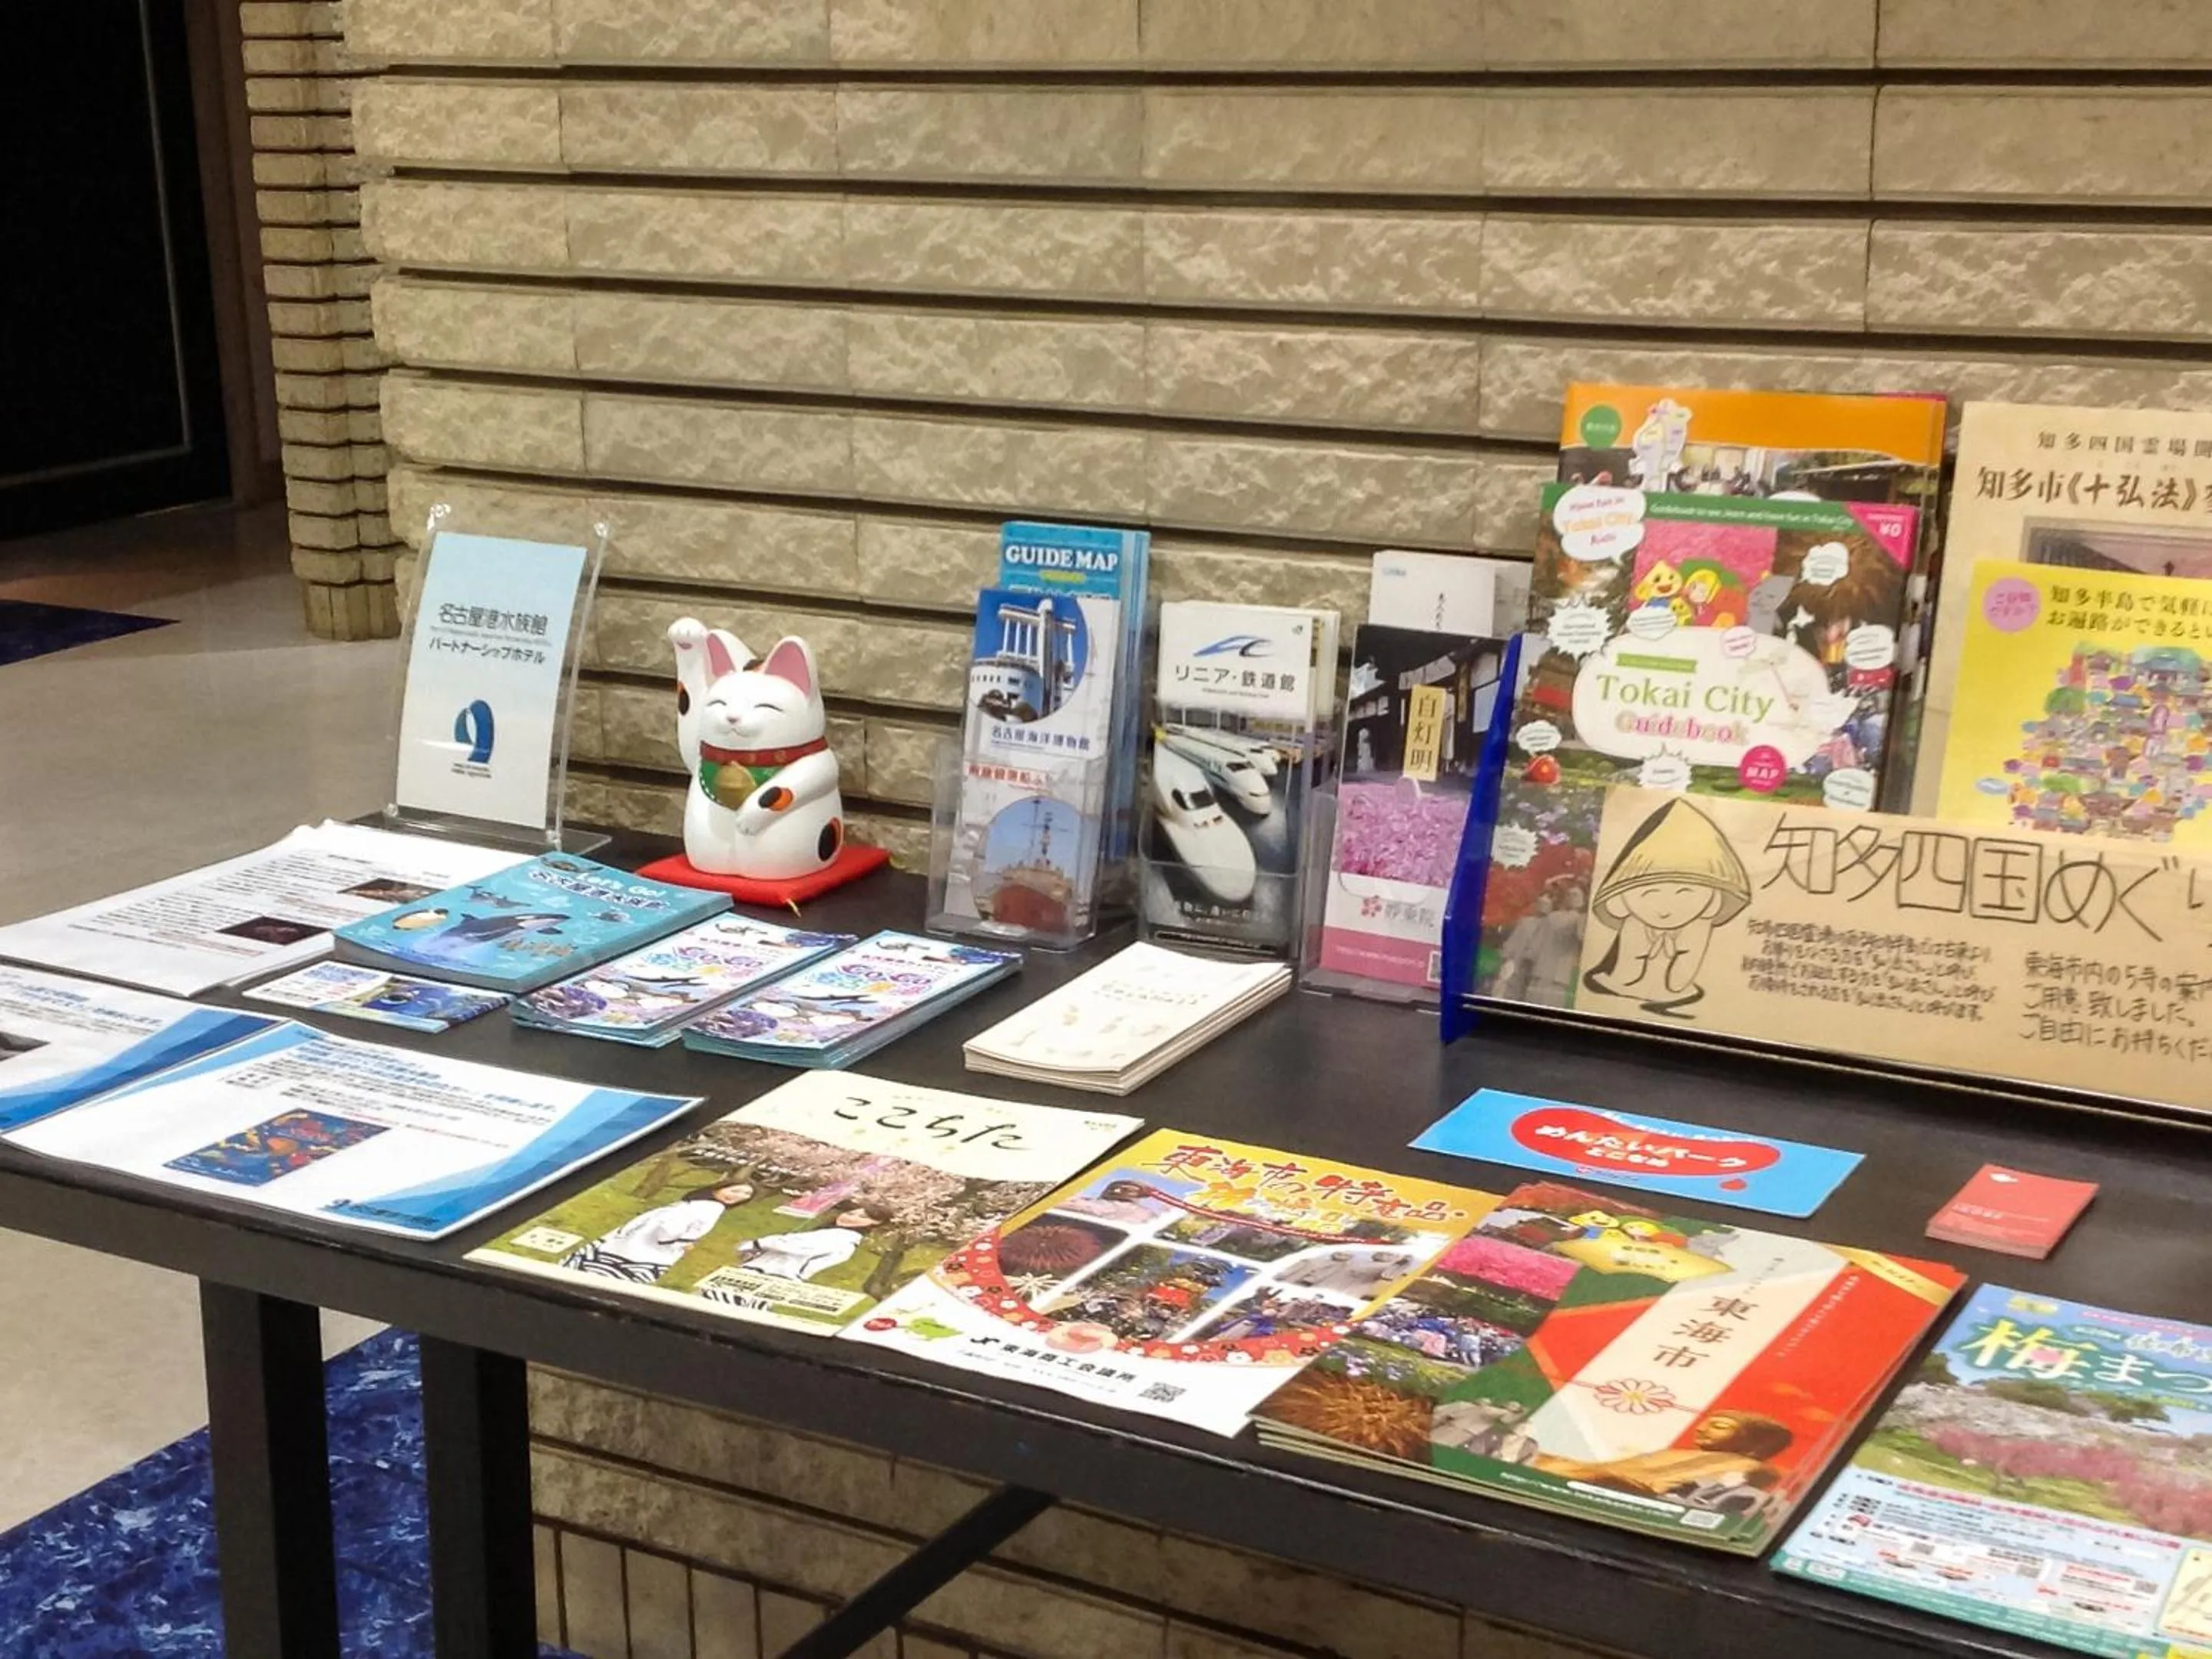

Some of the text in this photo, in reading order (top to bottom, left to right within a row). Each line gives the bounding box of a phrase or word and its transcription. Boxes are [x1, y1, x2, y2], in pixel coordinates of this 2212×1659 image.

[1975, 465, 2212, 512] 知多市《十弘法》
[1005, 545, 1118, 571] GUIDE MAP
[439, 603, 548, 635] 名古屋港水族館
[427, 637, 545, 664] パートナーシップホテル
[1176, 664, 1296, 691] リニア・鉄道館
[1596, 674, 1774, 724] Tokai City
[2018, 1013, 2212, 1062] ご自由にお持ちくだ
[1536, 1125, 1746, 1167] めんたいパーク
[1651, 1295, 1759, 1369] 東海市
